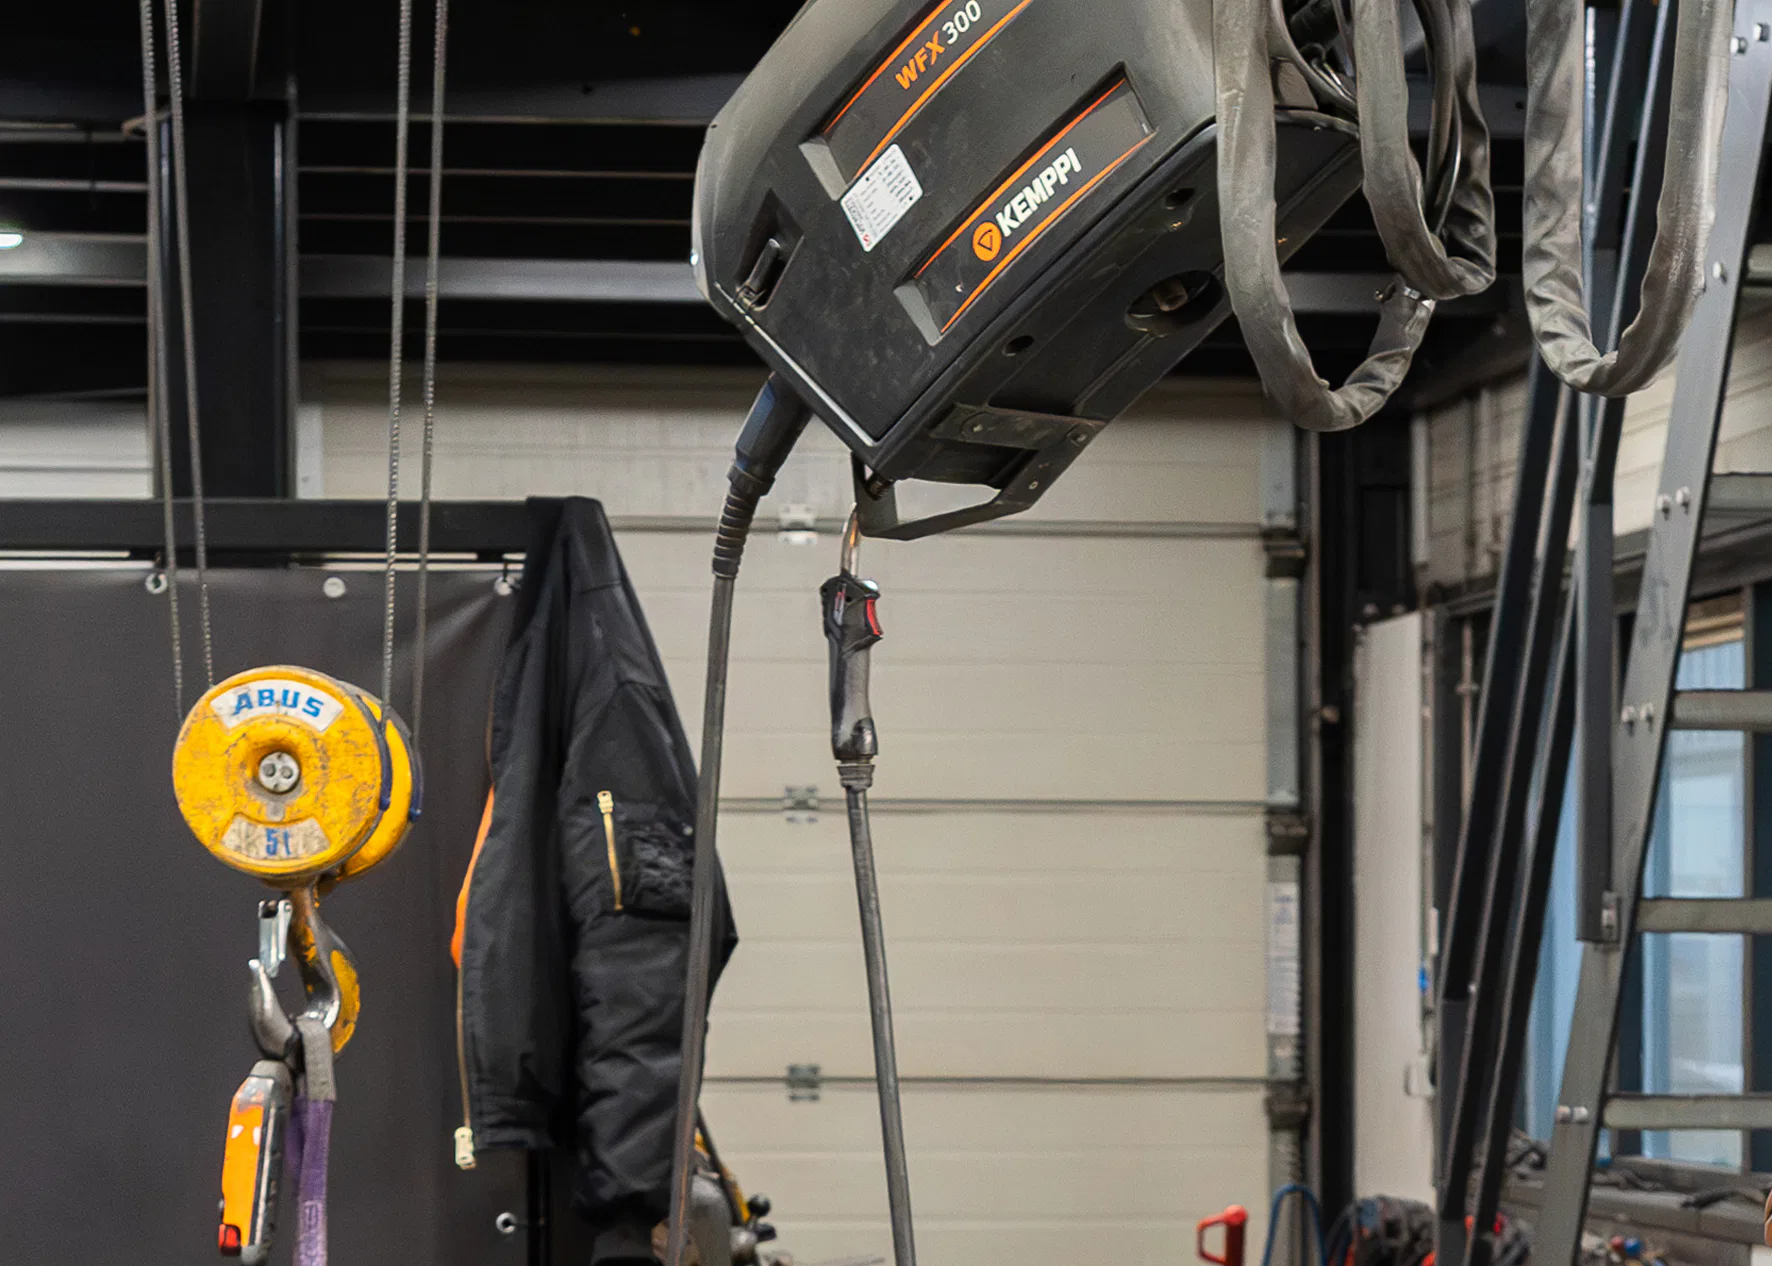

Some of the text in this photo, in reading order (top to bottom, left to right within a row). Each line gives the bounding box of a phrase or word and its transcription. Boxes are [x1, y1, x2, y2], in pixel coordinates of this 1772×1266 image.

[895, 0, 982, 90] WFX 300
[995, 147, 1082, 238] KEMPPI
[231, 689, 324, 718] ABUS
